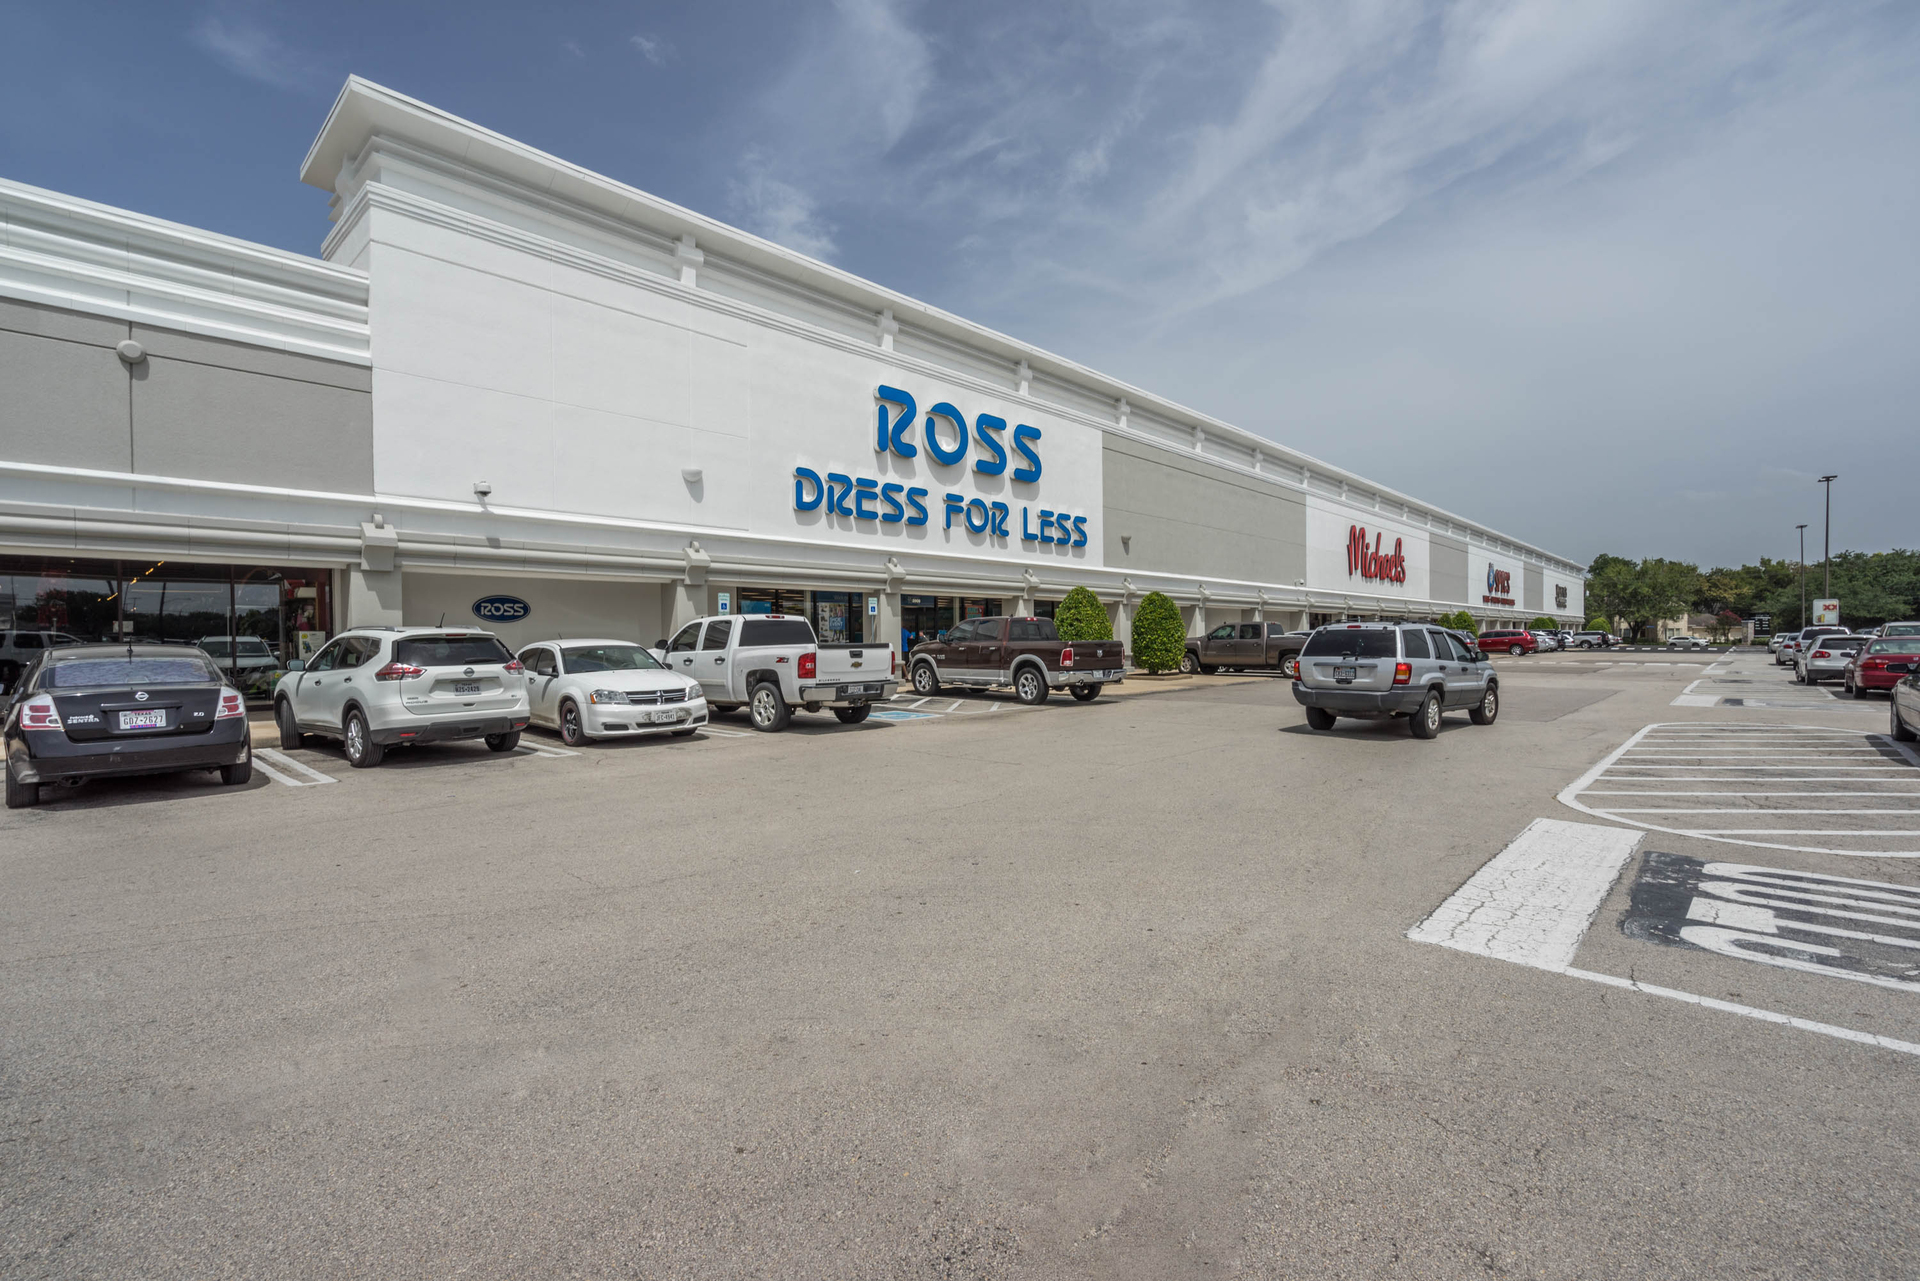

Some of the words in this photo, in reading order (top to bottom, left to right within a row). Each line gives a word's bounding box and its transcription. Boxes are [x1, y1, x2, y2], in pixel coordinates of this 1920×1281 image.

[875, 384, 1042, 483] ROSS
[794, 467, 929, 526] DRESS
[944, 493, 1009, 537] FOR
[1021, 506, 1088, 547] LESS
[1347, 524, 1406, 584] Michaels
[480, 603, 524, 616] ROSS
